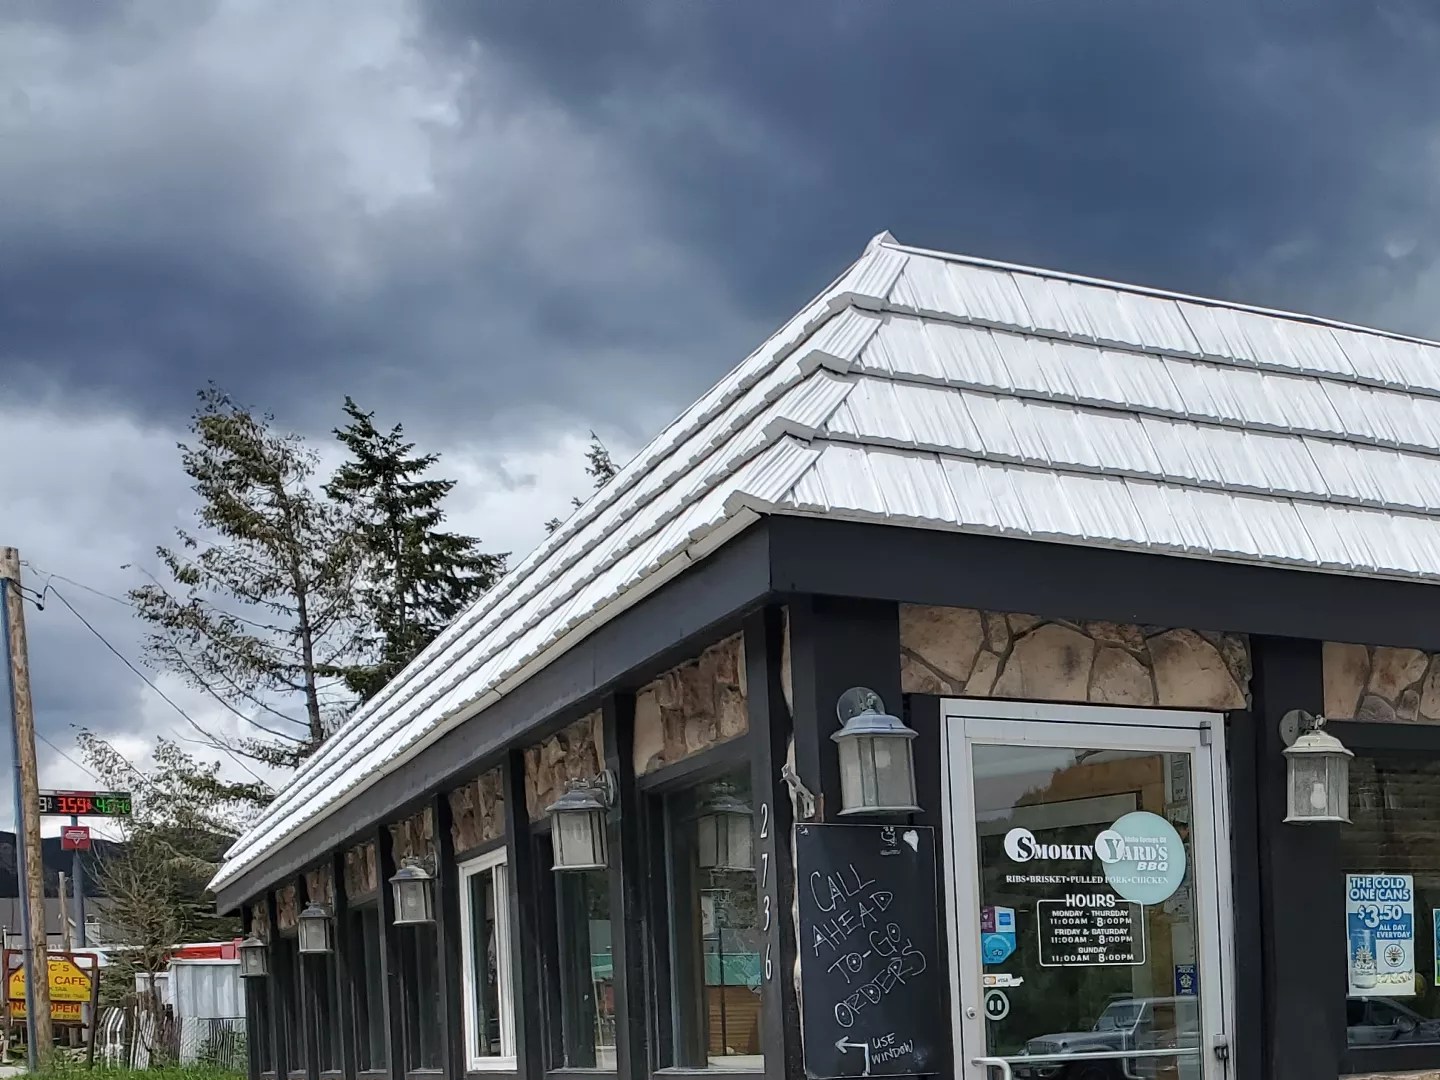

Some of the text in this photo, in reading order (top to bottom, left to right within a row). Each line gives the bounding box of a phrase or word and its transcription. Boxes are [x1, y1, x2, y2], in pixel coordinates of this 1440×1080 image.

[1017, 836, 1169, 861] SMOKIN YARD'S
[1136, 861, 1169, 872] BBQ
[760, 803, 772, 980] 2736
[810, 863, 876, 912] CALL
[1350, 877, 1405, 889] THE COLD
[1350, 888, 1410, 900] ONE CANS
[1065, 893, 1116, 908] HOURS
[813, 891, 893, 957] AHEAD
[1357, 904, 1403, 928] $3.50
[54, 975, 86, 986] CAFE
[834, 938, 926, 1028] ORDERS
[871, 1039, 913, 1065] WINDOW
[872, 1032, 896, 1049] USE
